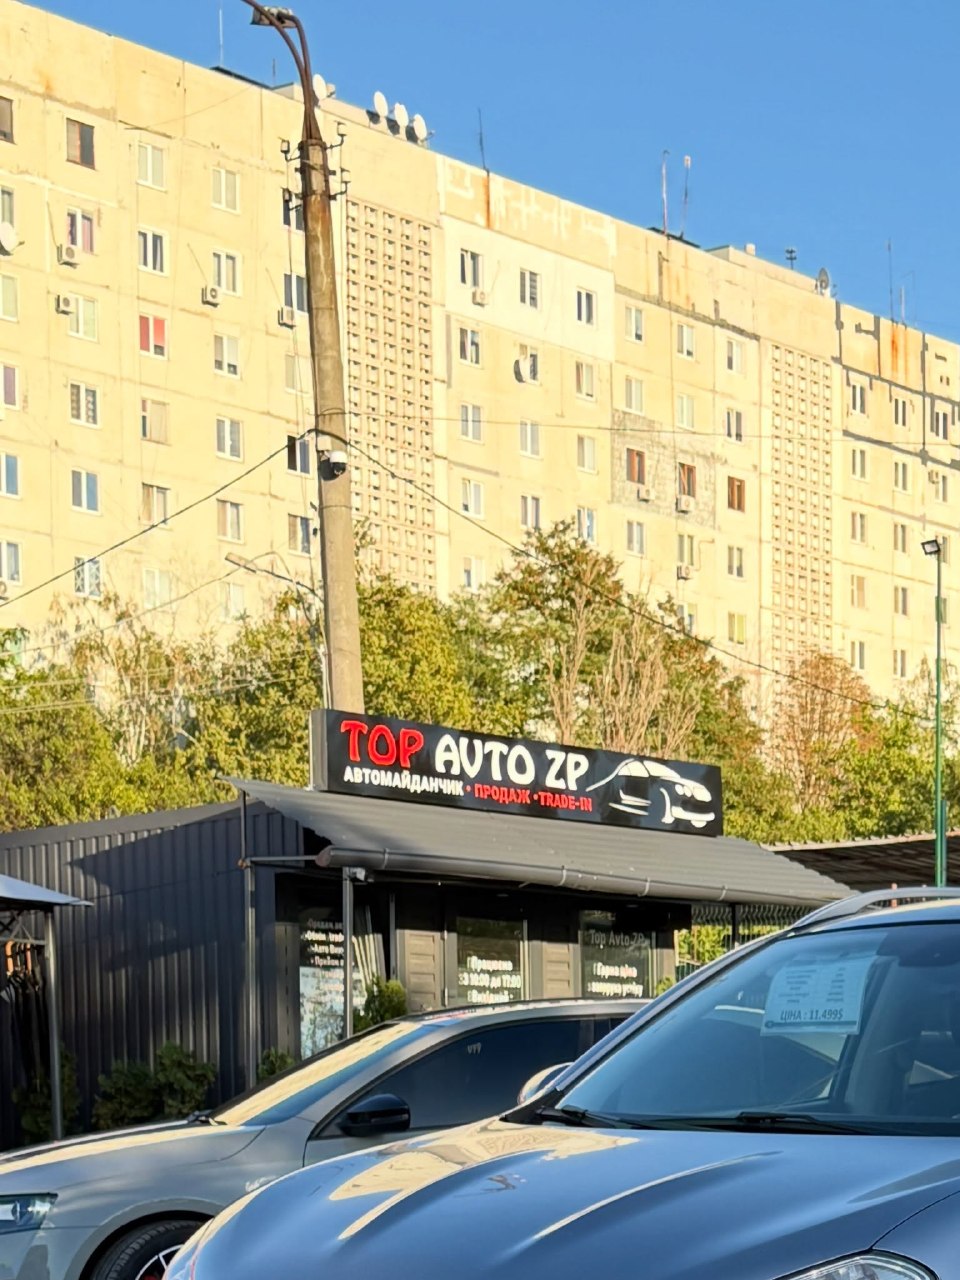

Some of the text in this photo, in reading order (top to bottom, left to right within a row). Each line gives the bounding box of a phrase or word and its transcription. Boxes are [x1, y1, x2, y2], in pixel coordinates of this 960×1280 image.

[341, 720, 424, 768] TOP
[545, 749, 589, 791] ZP
[344, 765, 592, 812] АВТОМАЙДАНЧИК ПРОДАЖ TRADE-IN
